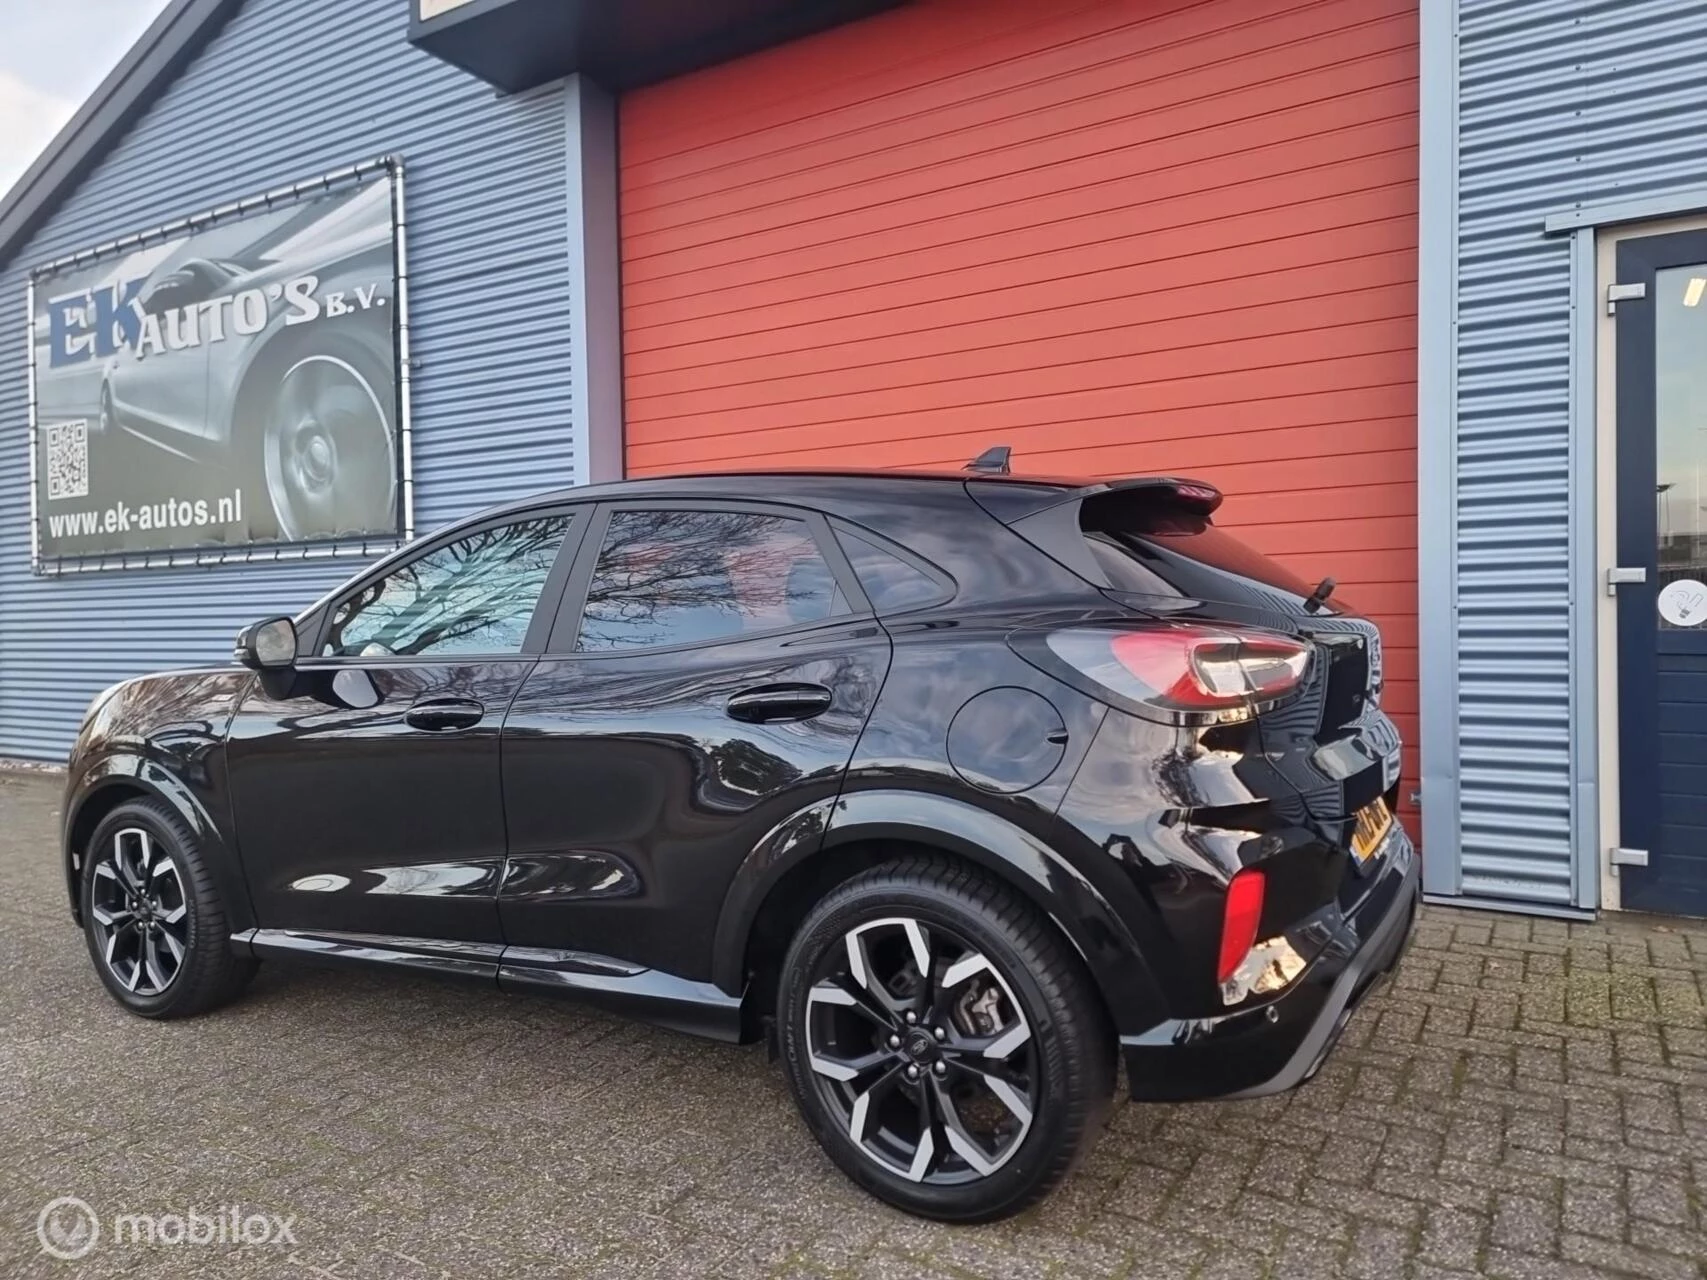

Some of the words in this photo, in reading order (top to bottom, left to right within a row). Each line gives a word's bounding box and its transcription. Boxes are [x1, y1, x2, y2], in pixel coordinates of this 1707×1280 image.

[48, 276, 149, 369] EK
[135, 275, 321, 360] AUTO'S
[326, 283, 387, 319] B.V.
[49, 488, 242, 538] www.ek-autos.nl
